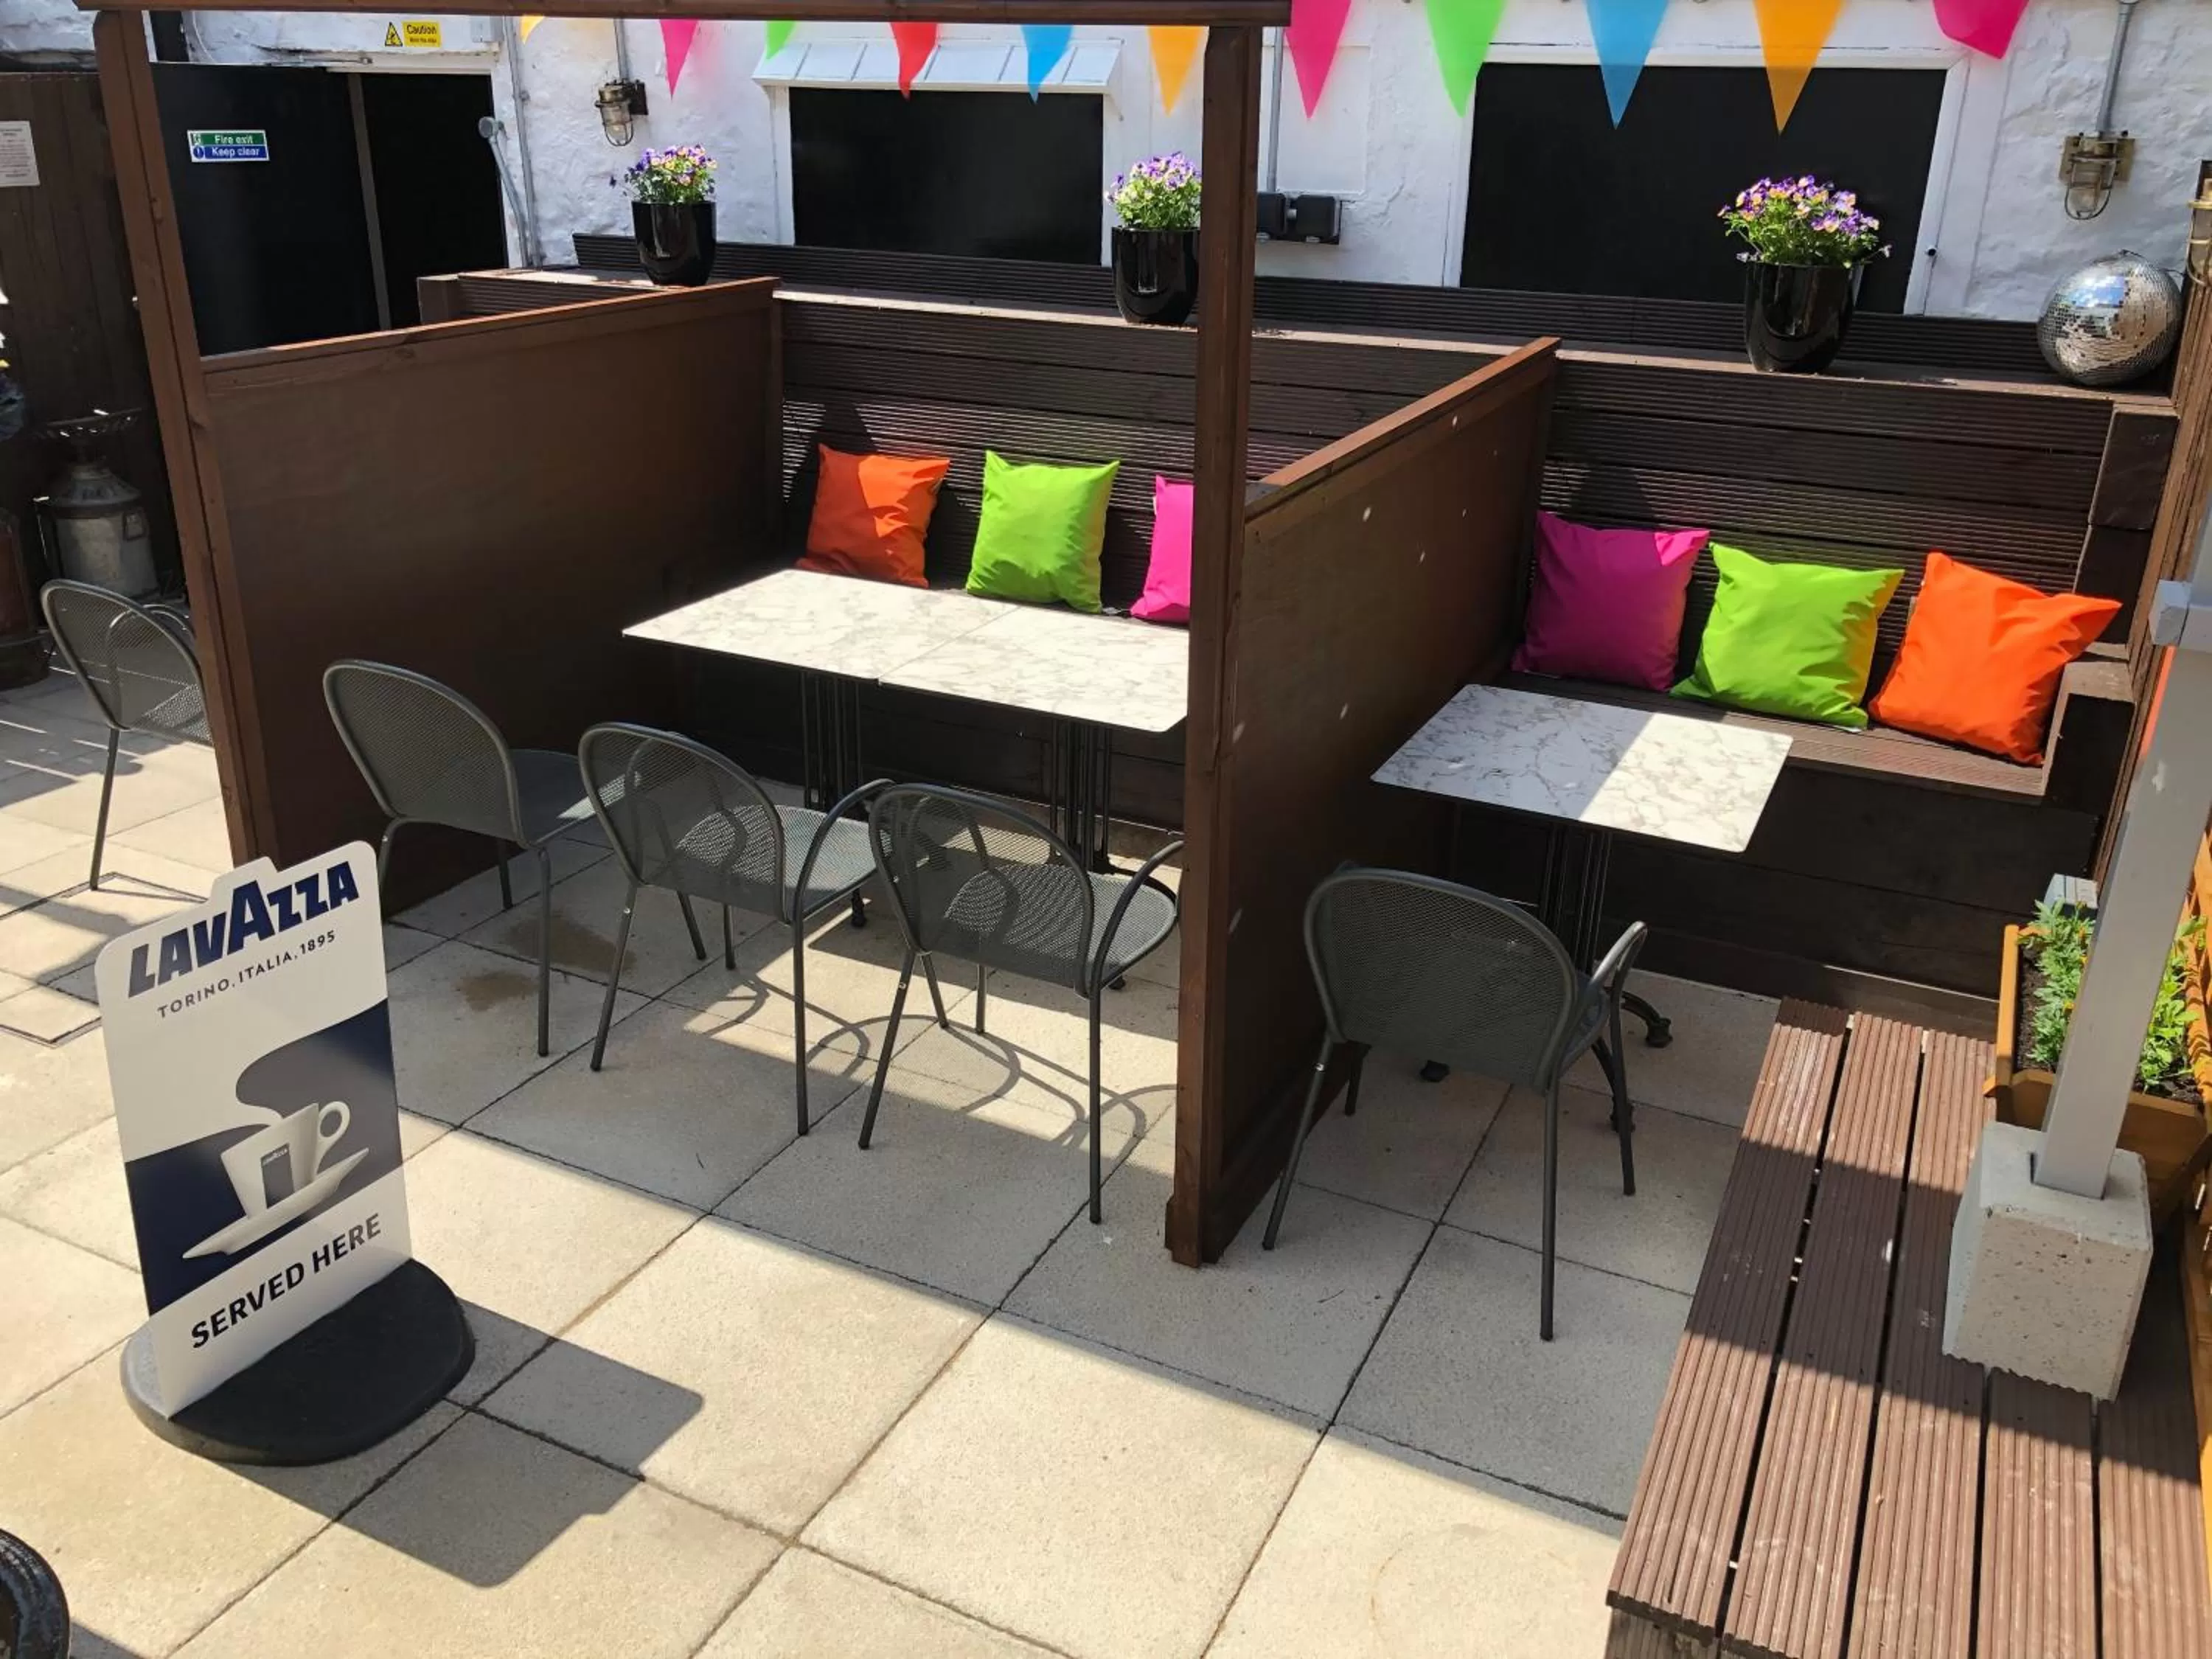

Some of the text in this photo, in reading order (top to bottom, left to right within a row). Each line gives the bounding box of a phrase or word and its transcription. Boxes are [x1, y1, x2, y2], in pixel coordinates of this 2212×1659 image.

[406, 24, 437, 34] Caution
[215, 135, 254, 144] Fire exit
[212, 147, 260, 159] Keep clear
[128, 861, 359, 998] LAVAZZA
[300, 930, 335, 954] 1895
[191, 1213, 382, 1349] SERVED HERE
